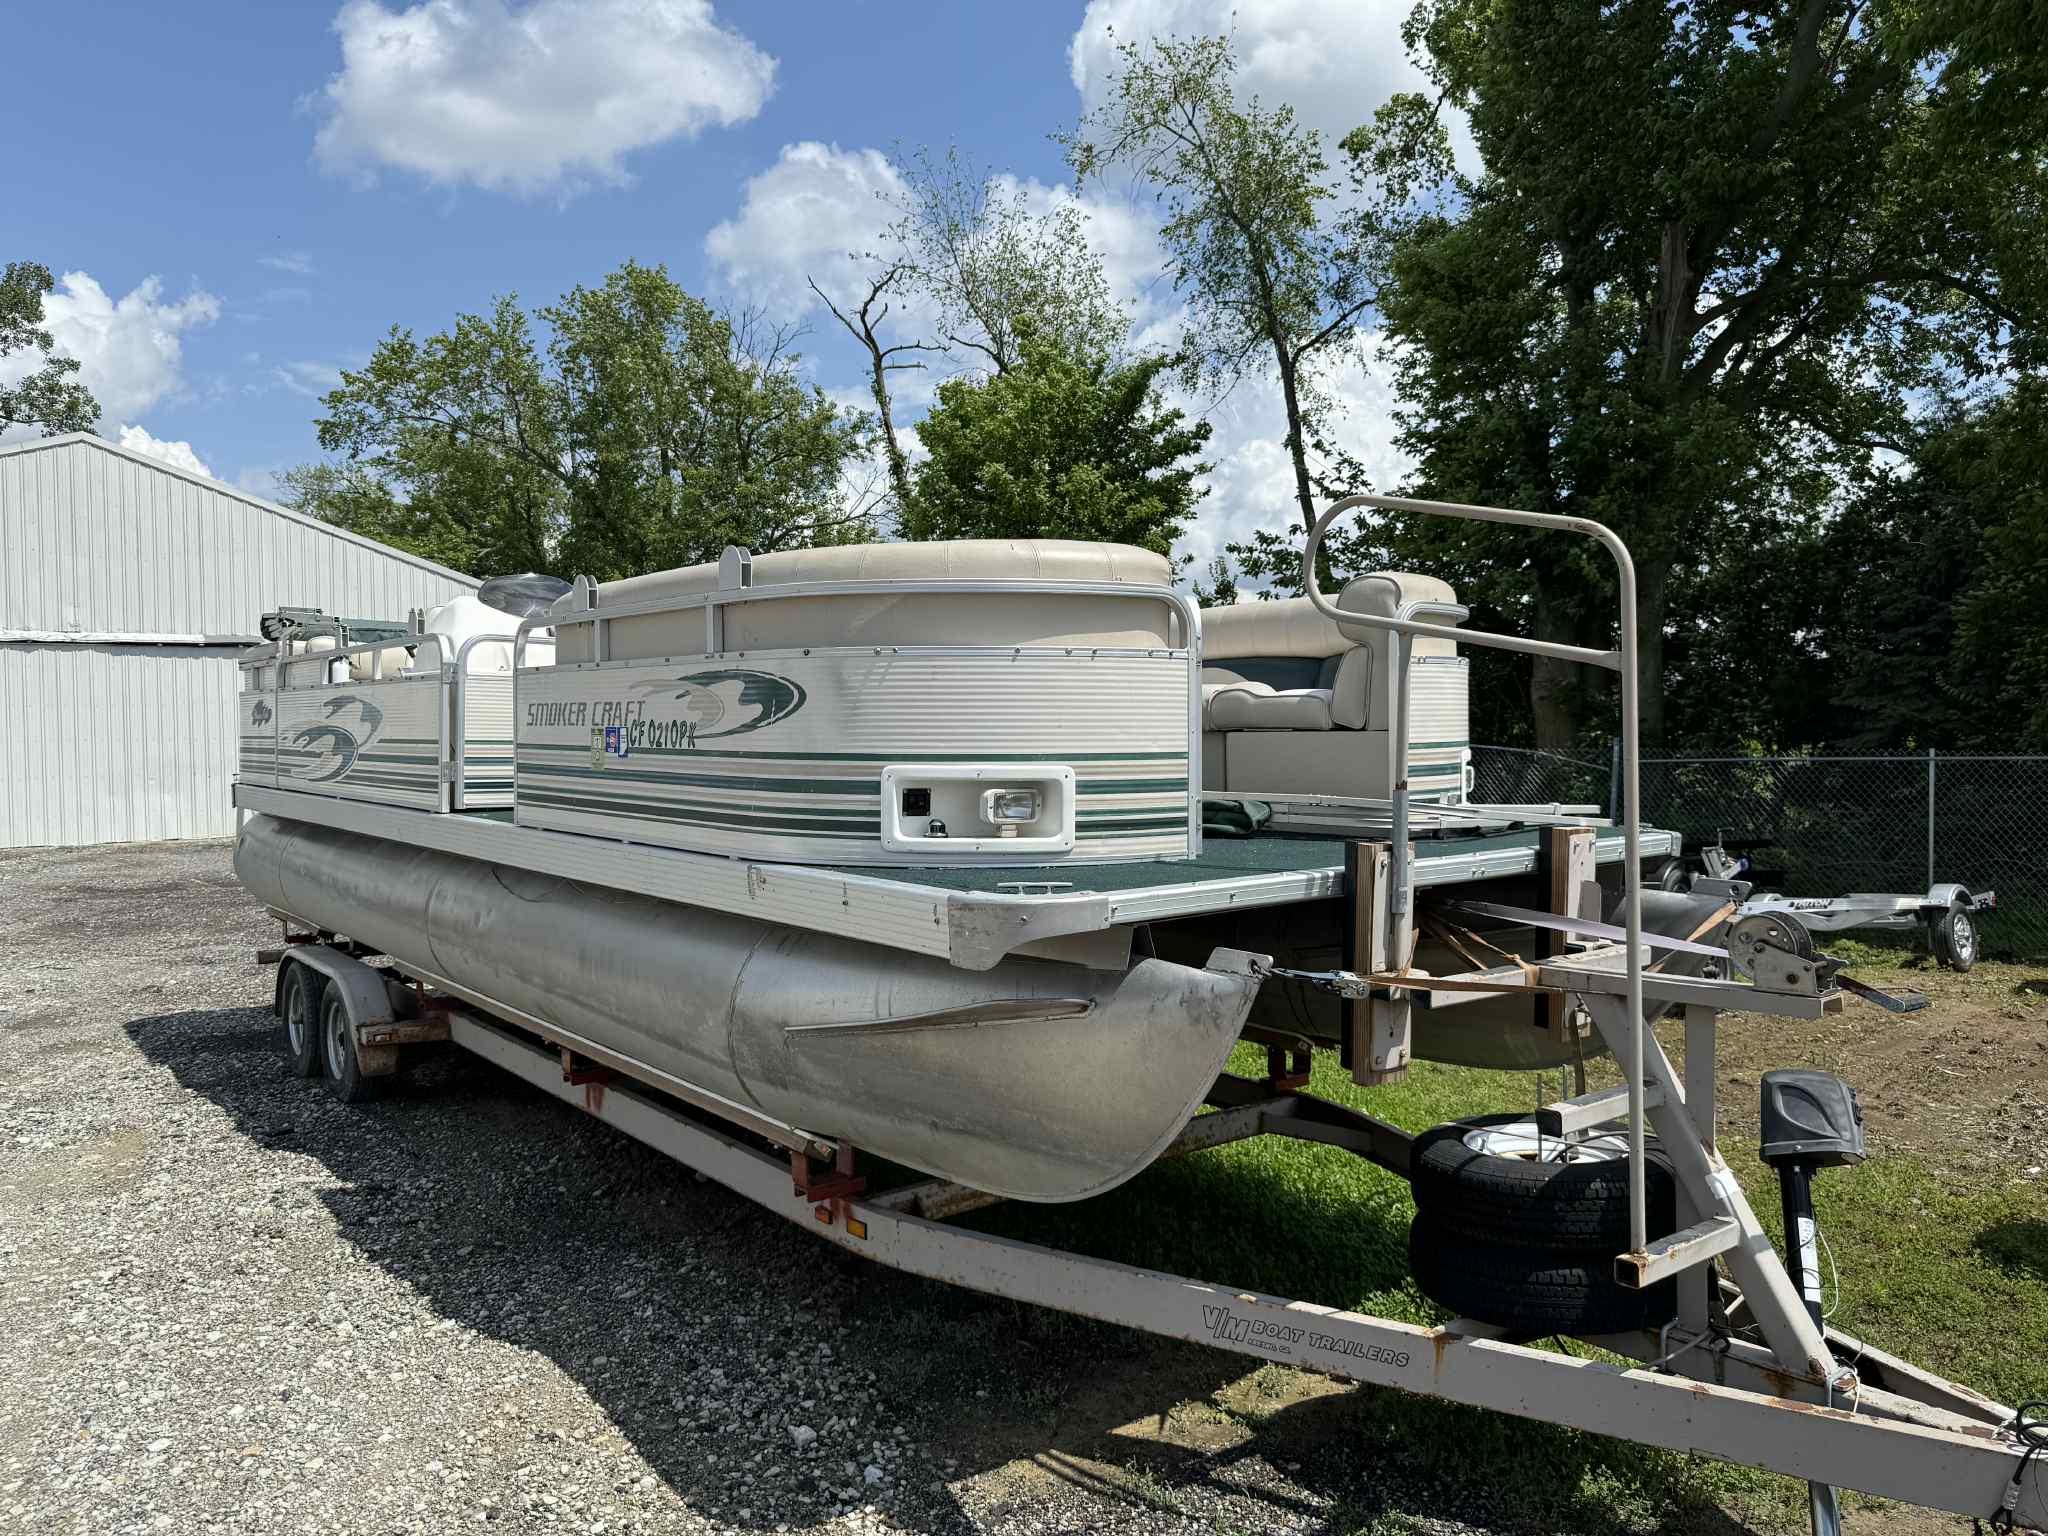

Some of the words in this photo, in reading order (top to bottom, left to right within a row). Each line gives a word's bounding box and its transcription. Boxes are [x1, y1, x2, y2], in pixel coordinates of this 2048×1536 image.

[527, 702, 587, 727] SMOKER
[591, 700, 646, 727] CRAFT
[629, 719, 646, 747] CF
[1251, 1319, 1304, 1344] BOAT
[1309, 1332, 1410, 1368] TRAILERS
